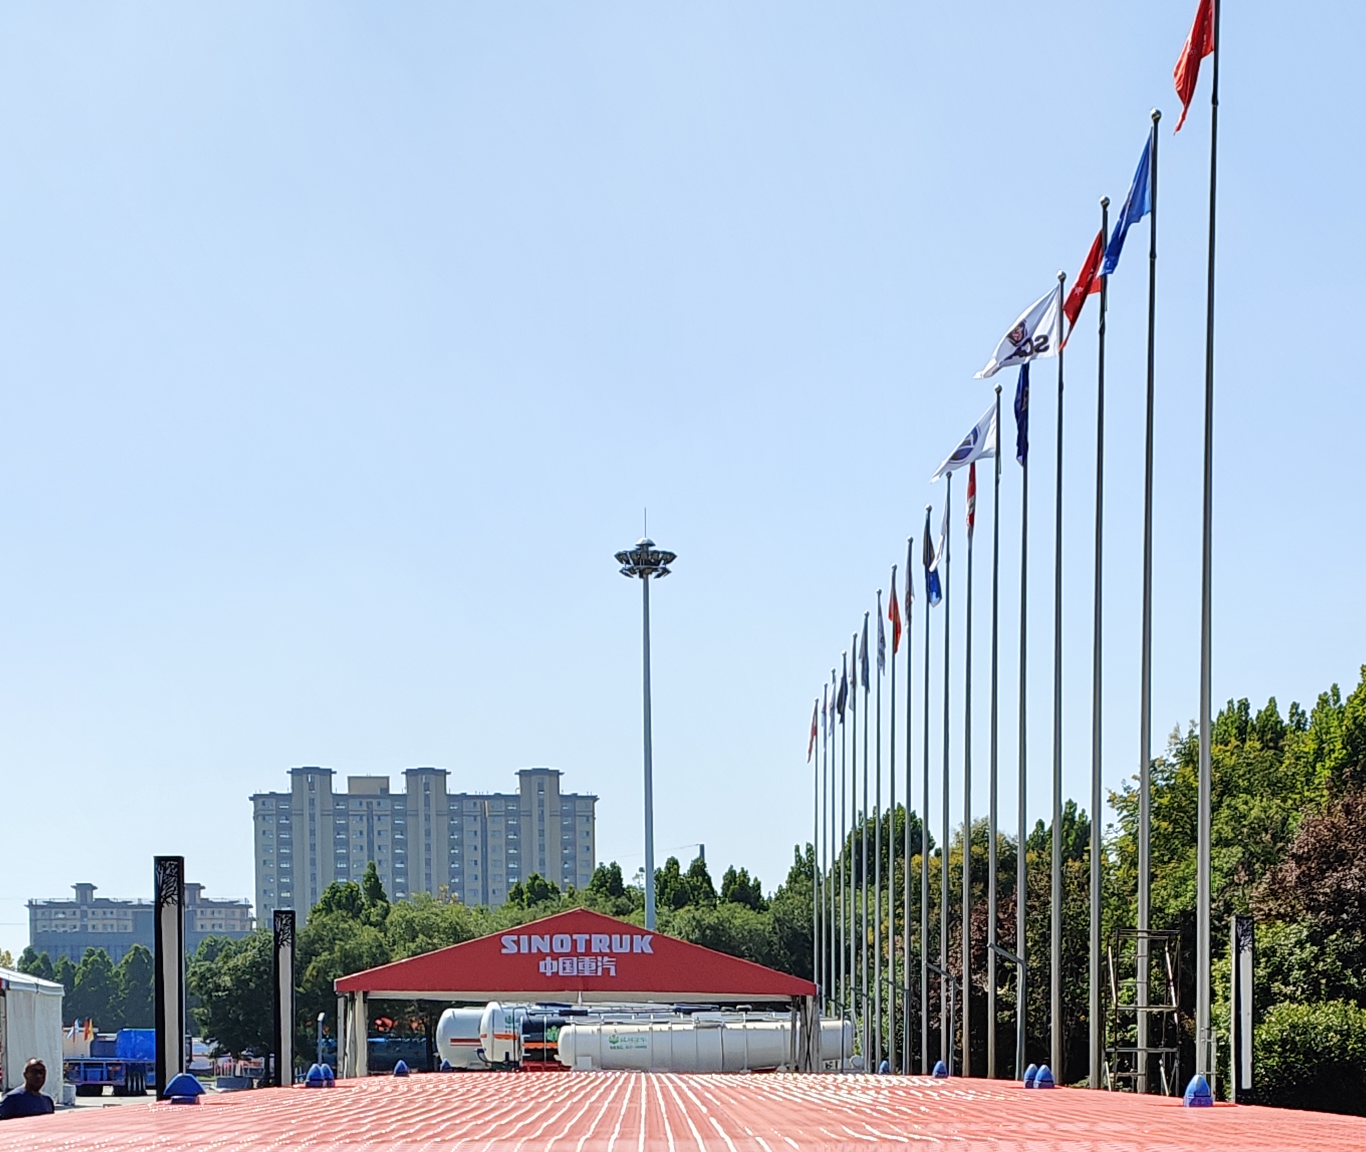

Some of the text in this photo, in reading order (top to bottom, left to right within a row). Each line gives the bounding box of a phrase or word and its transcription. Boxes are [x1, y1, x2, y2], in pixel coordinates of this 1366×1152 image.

[500, 933, 654, 954] SINOTRUK
[539, 956, 617, 976] 中国重汽
